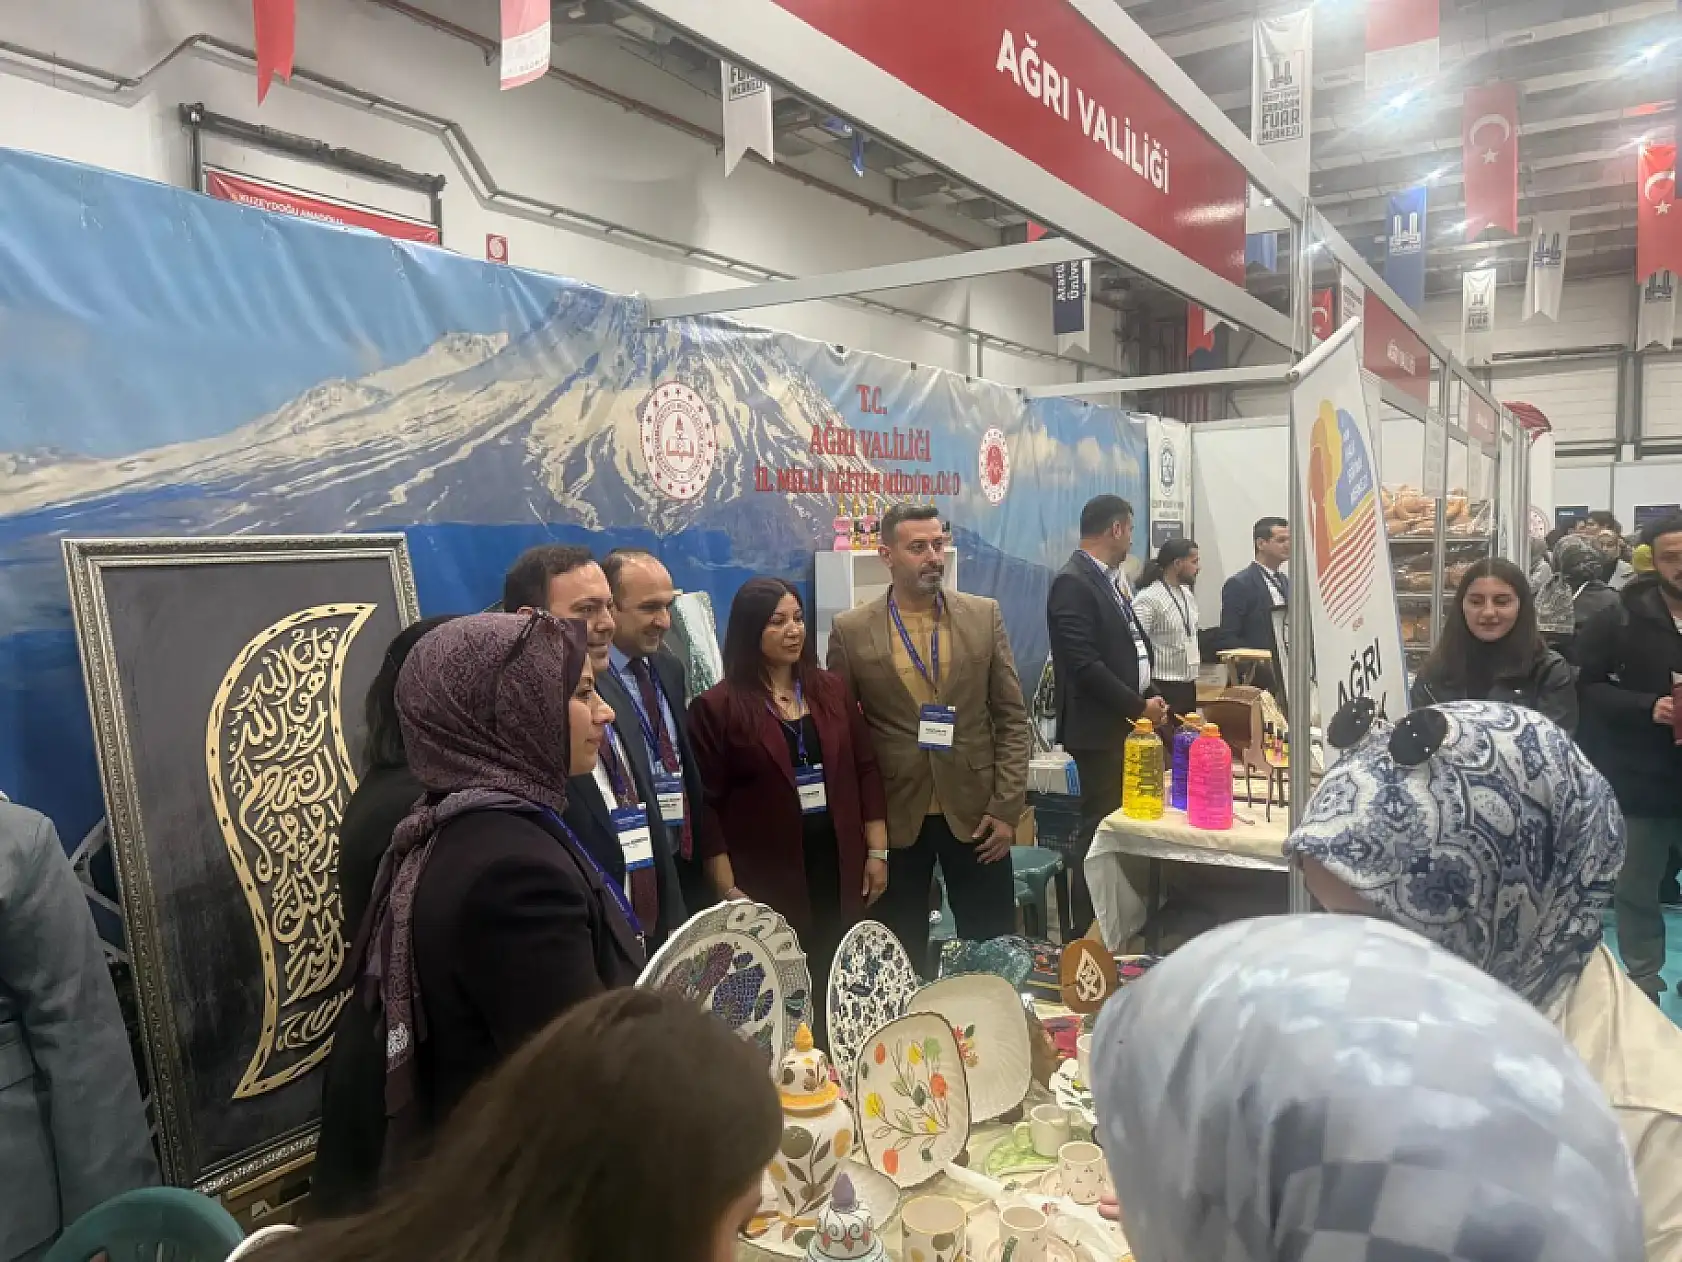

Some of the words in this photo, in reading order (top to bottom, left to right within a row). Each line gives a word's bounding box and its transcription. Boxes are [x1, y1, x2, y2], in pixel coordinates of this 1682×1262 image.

[996, 29, 1070, 121] AĞRI
[1076, 87, 1170, 195] VALİLİĞİ
[856, 384, 888, 415] T.C.
[809, 420, 857, 456] AĞRI
[858, 427, 932, 463] VALİLİĞİ
